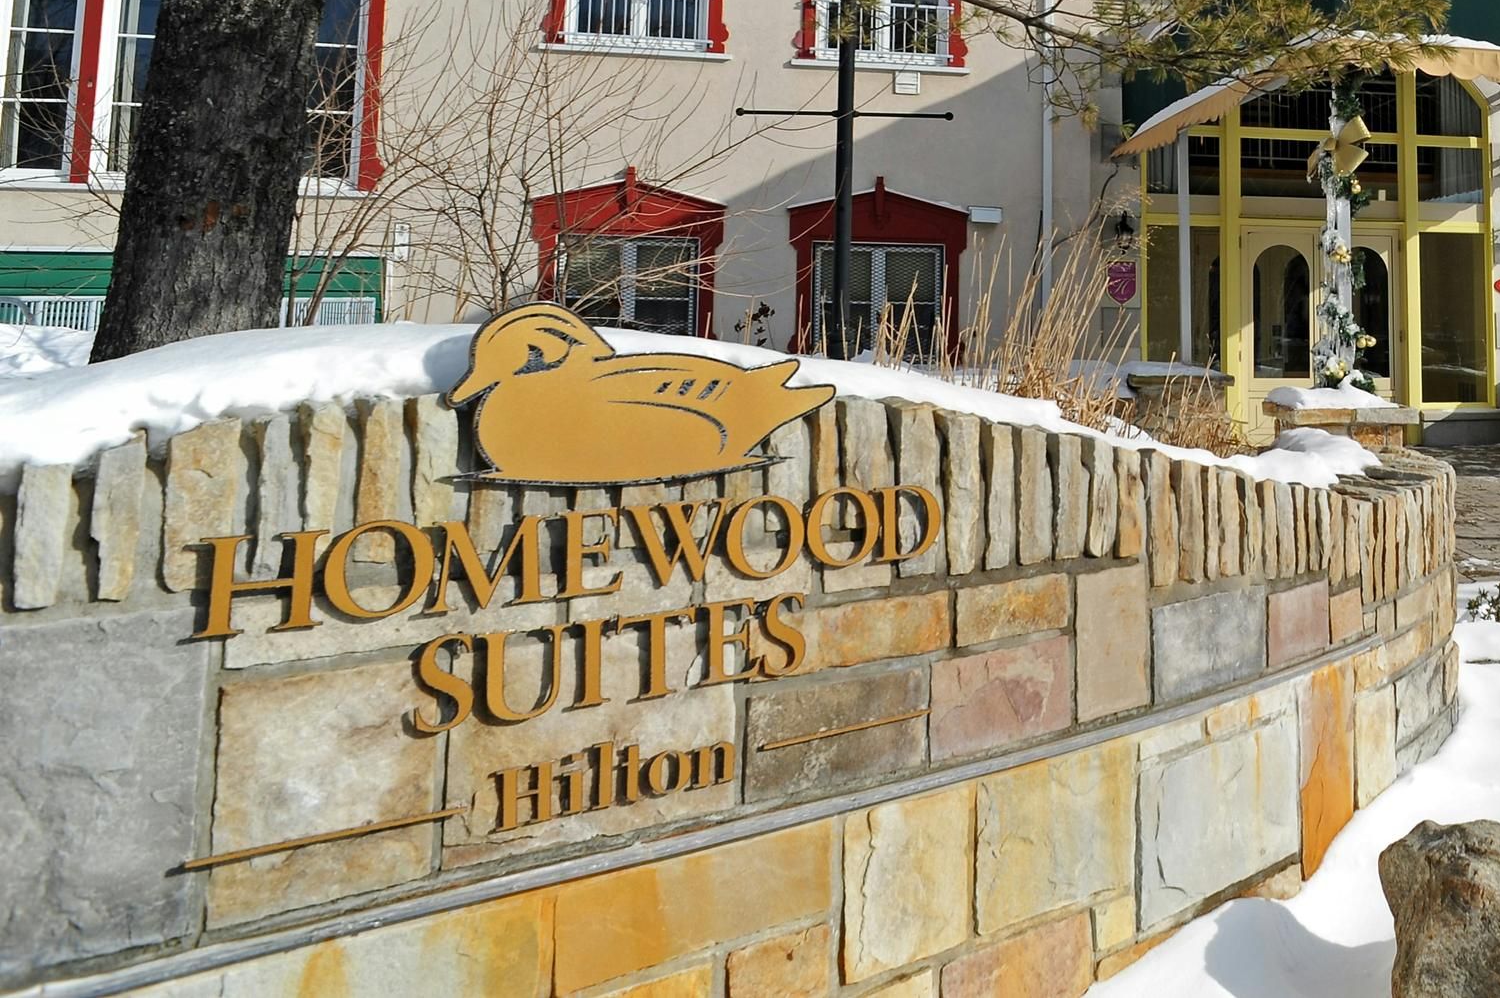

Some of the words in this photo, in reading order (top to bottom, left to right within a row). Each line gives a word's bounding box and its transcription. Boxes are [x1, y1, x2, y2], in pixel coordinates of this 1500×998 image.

[191, 484, 942, 640] HOMEWOOD
[412, 592, 807, 734] SUITES
[496, 739, 736, 831] Hilton
